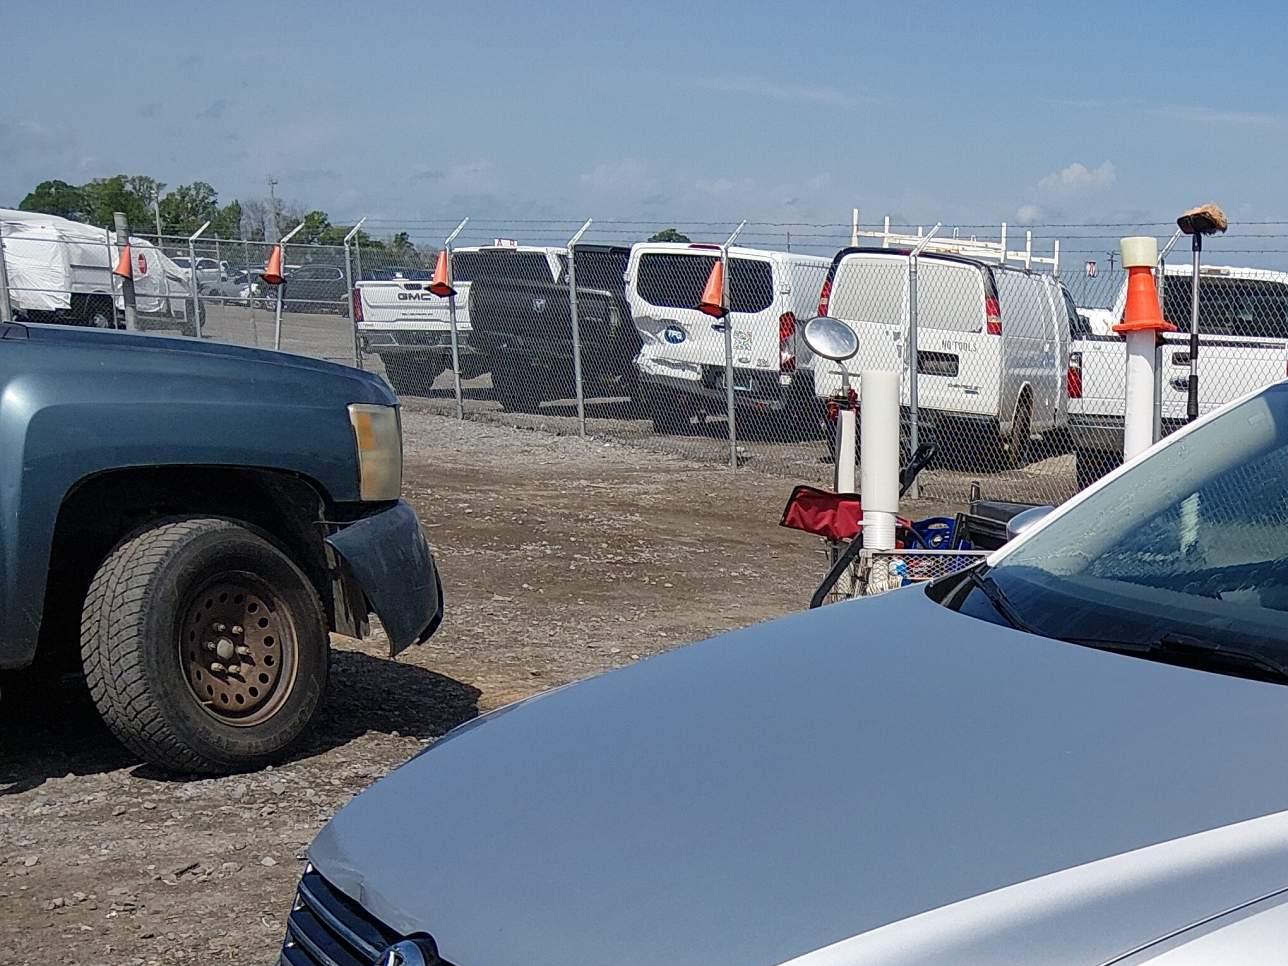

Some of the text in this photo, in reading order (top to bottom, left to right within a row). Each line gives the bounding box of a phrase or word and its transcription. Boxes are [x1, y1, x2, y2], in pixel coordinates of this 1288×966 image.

[397, 292, 433, 301] GMC
[942, 340, 977, 352] NO TOOLS
